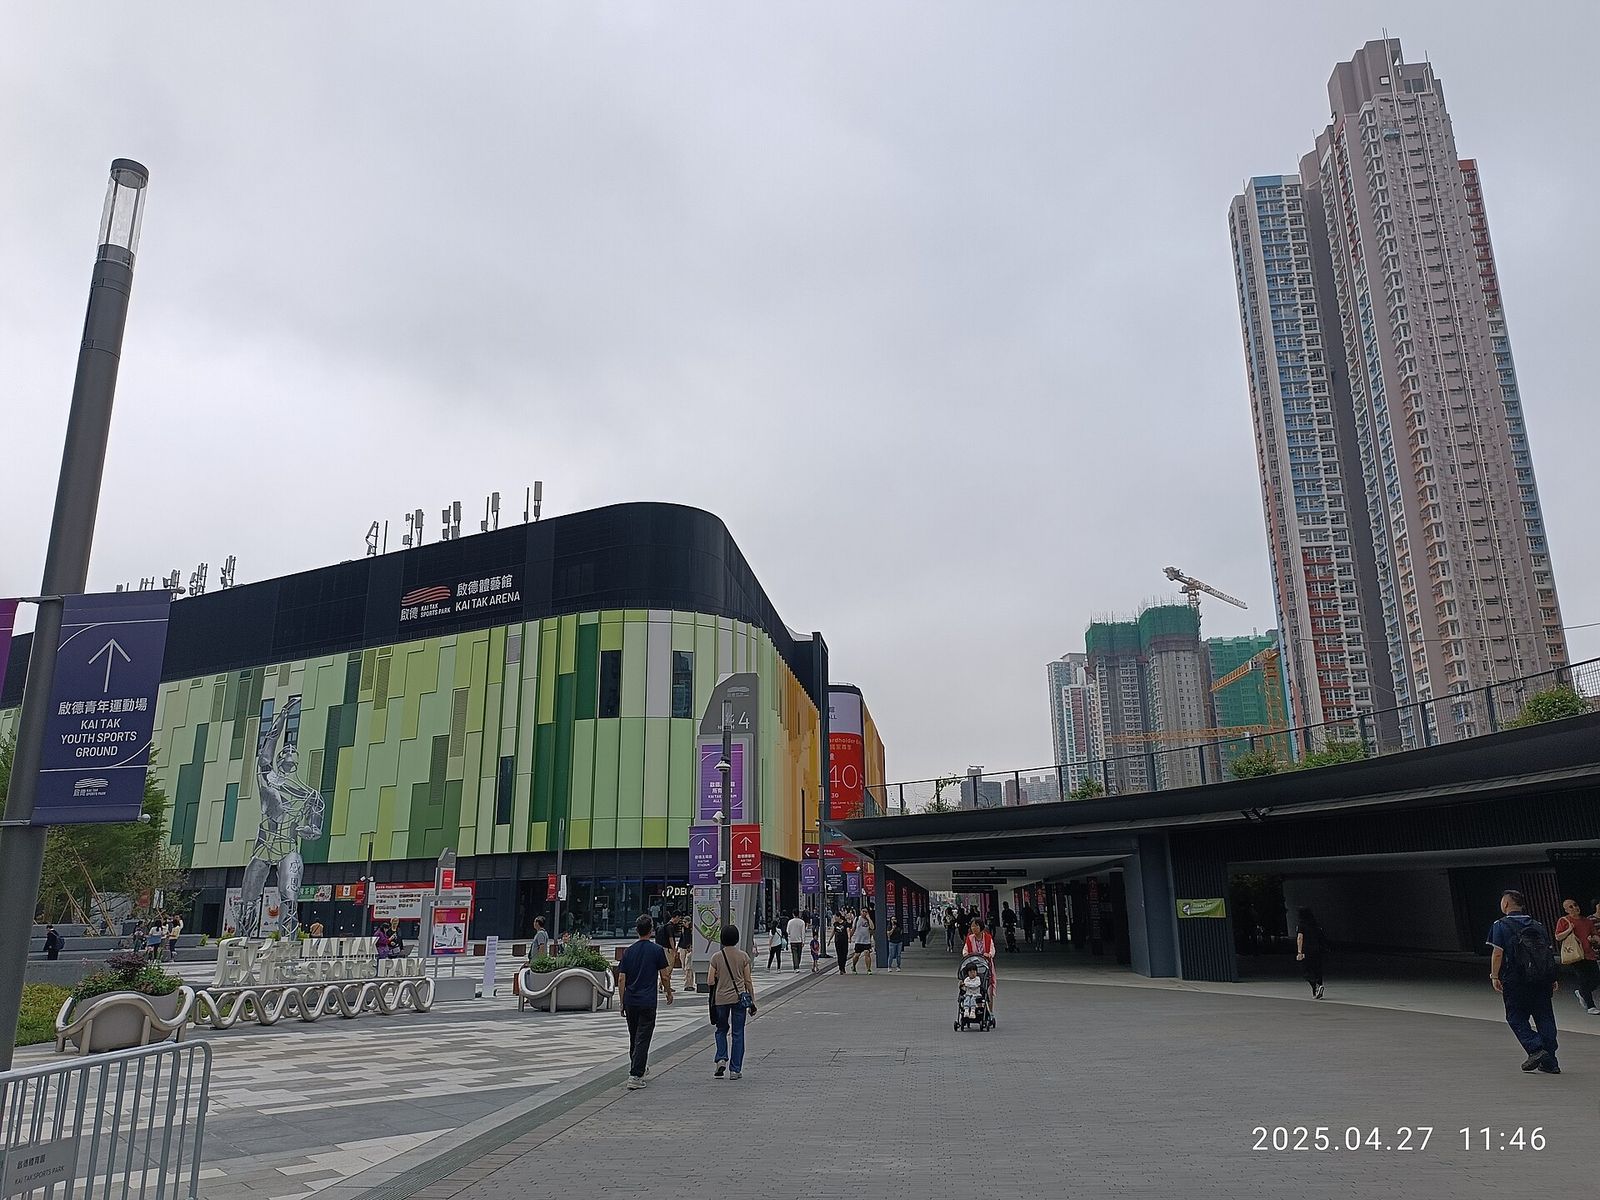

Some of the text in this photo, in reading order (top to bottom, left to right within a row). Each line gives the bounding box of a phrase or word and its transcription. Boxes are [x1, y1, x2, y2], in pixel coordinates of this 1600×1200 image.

[456, 574, 513, 597] 啟德體藝館
[455, 591, 520, 612] KAI TAK ARENA
[400, 606, 419, 622] 啟德
[420, 606, 451, 618] SPORTS PARK
[58, 697, 148, 715] 啟德青年運動場
[80, 717, 121, 730] KAI TAK
[738, 711, 750, 729] 4
[60, 730, 138, 745] YOUTH SPORTS
[75, 745, 118, 758] GROUND
[303, 937, 380, 956] KAI TAK
[305, 958, 426, 980] SPORTS PARK
